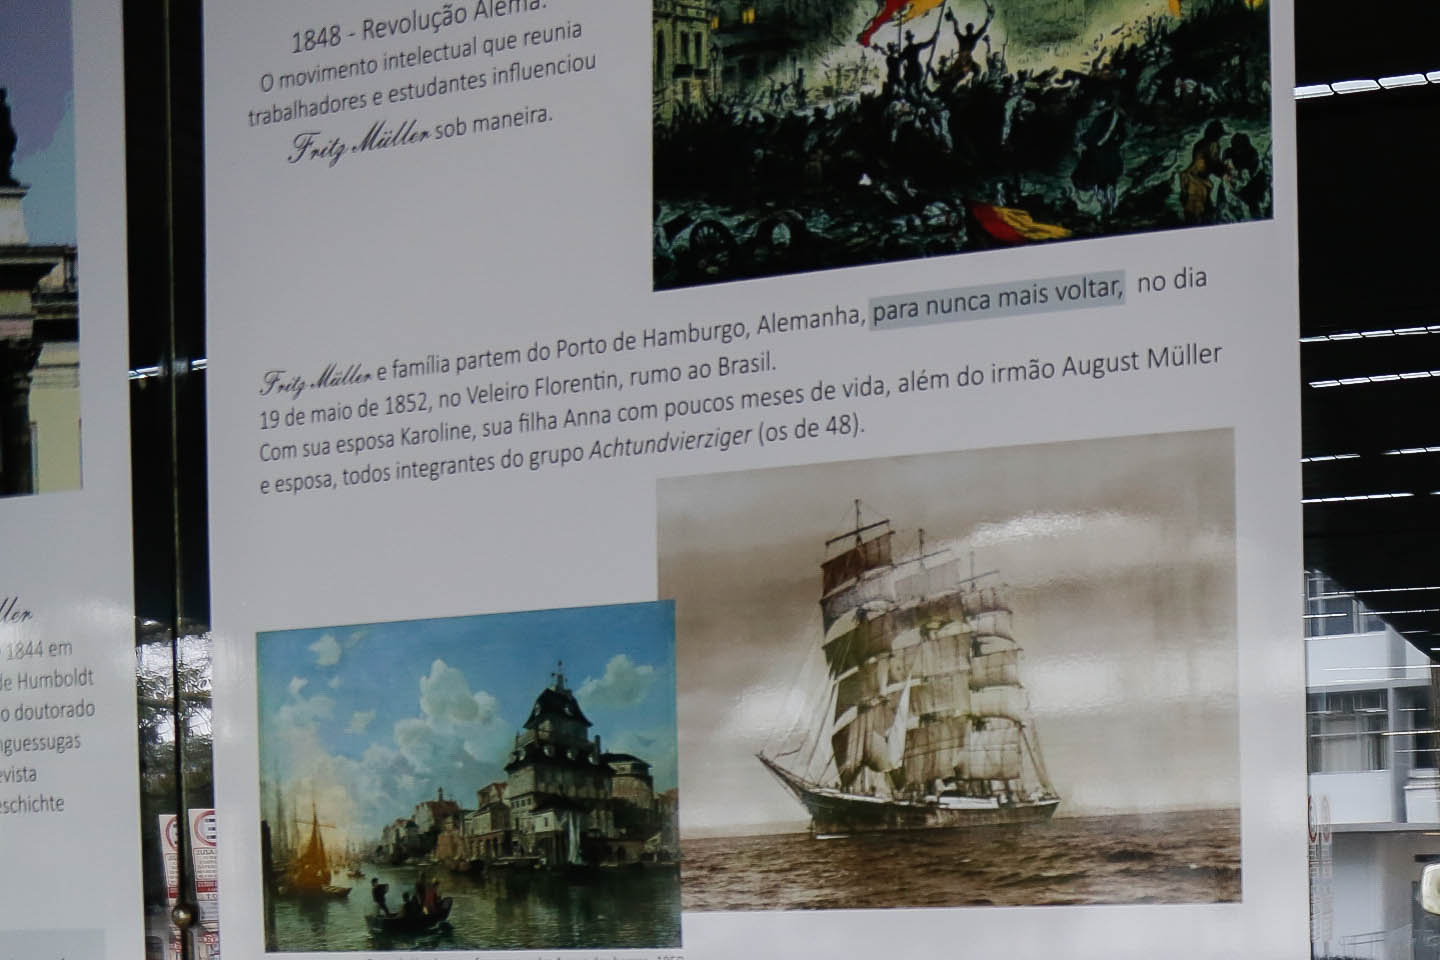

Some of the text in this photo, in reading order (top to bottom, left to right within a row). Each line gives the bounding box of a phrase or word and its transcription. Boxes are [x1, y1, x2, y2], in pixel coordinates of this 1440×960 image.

[279, 20, 582, 88] movimento intelectual que reunia
[291, 24, 341, 54] 1848
[362, 3, 467, 40] Revolução
[248, 54, 596, 127] trabalhadores estudantes influenciou
[287, 106, 553, 168] Fritz Müller sob maneira.
[259, 266, 1207, 400] Fritz Müller família partem Porto Hamburgo, Alemanha, para nunca mais voltar, dia
[259, 342, 1223, 462] Com sua esposa Karoline, sua filha Anna com poucos meses vida, além irmão August Müller
[310, 350, 776, 424] maio 1852, Veleiro Florentin, rumo Brasil.
[274, 412, 865, 496] esposa, todos integrantes grupo Achtundvierziger (os 48).
[7, 640, 43, 660] 1844
[18, 668, 95, 690] Humboldt
[14, 697, 96, 721] doutorado
